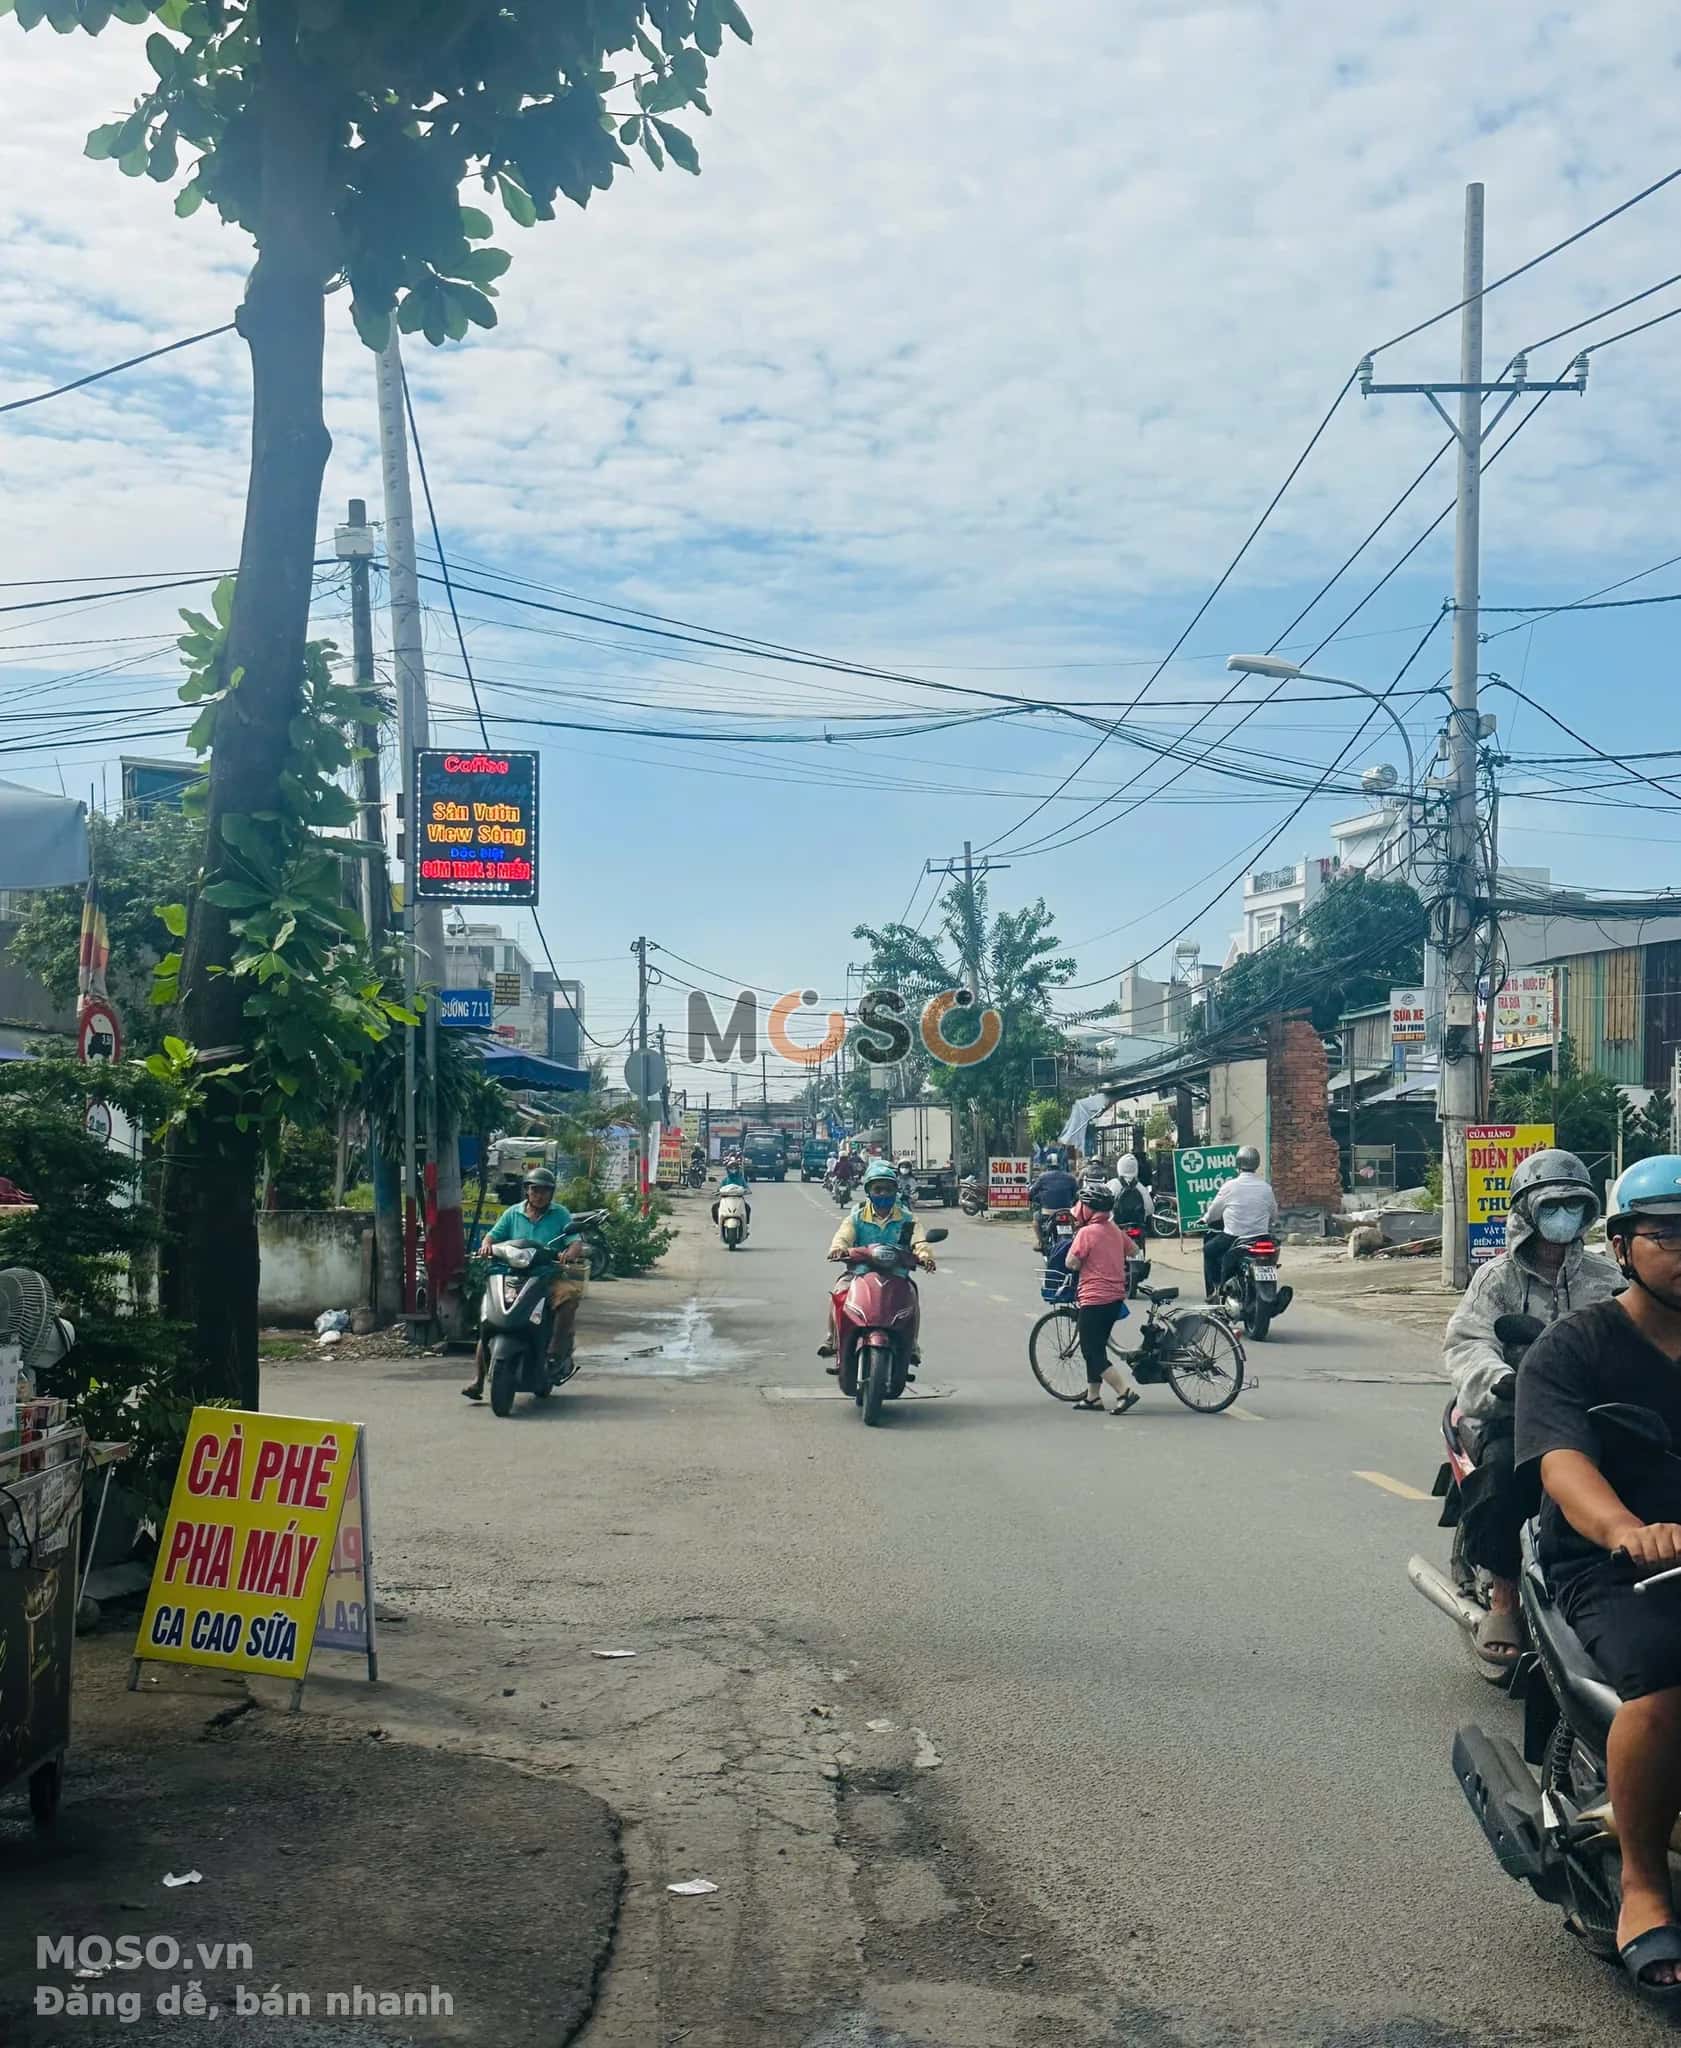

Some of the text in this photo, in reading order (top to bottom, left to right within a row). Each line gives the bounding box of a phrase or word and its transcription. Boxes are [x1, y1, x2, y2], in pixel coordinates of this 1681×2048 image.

[444, 755, 510, 774] Coffee
[433, 802, 520, 822] Sân Vườn
[427, 824, 526, 846] View Sông
[486, 863, 496, 879] 3
[471, 1001, 490, 1017] 711
[1413, 1008, 1425, 1021] XE
[1469, 1128, 1511, 1138] CỬA HÀNG
[991, 1159, 1028, 1174] SỬA XE
[1206, 1152, 1237, 1169] NHÀ
[1471, 1141, 1508, 1175] ĐIỆN
[1187, 1172, 1233, 1193] THUỐ
[187, 1423, 245, 1499] CÀ
[251, 1435, 340, 1511] PHÊ
[163, 1521, 236, 1590] PHA
[237, 1520, 320, 1599] MÁY
[151, 1605, 298, 1662] CA CAO SỮA
